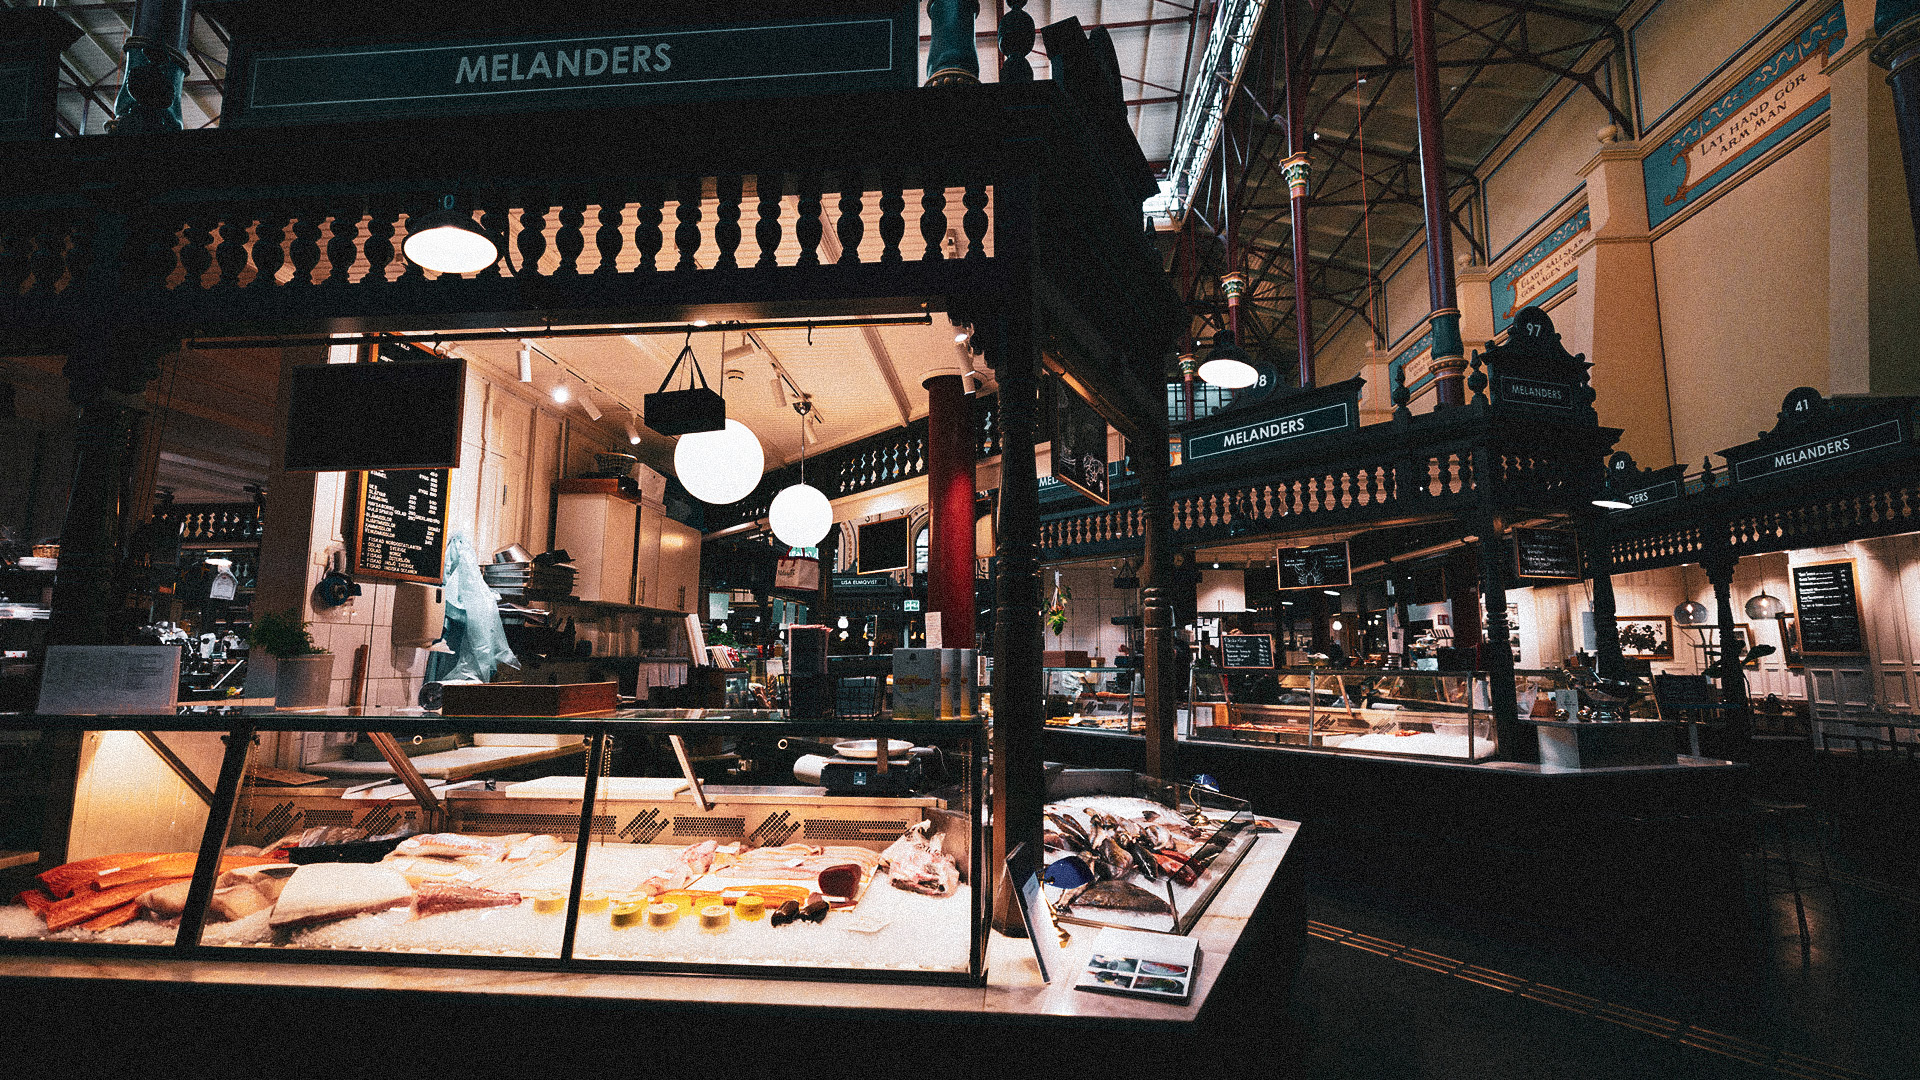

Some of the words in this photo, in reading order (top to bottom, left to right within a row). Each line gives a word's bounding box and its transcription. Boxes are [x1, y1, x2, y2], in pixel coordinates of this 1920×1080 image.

[455, 43, 671, 84] MELANDERS
[1701, 133, 1725, 156] LAT
[1730, 101, 1769, 136] HAND
[1774, 73, 1808, 101] GÖR
[1720, 130, 1750, 156] ARM
[1754, 101, 1787, 132] MAN
[1525, 322, 1541, 337] 97
[1511, 384, 1562, 400] MELANDERS
[1794, 398, 1809, 412] 41
[1223, 417, 1305, 447] MELANDERS
[1773, 438, 1850, 468] MELANDERS
[1615, 460, 1625, 470] 40
[1038, 475, 1058, 487] MEL
